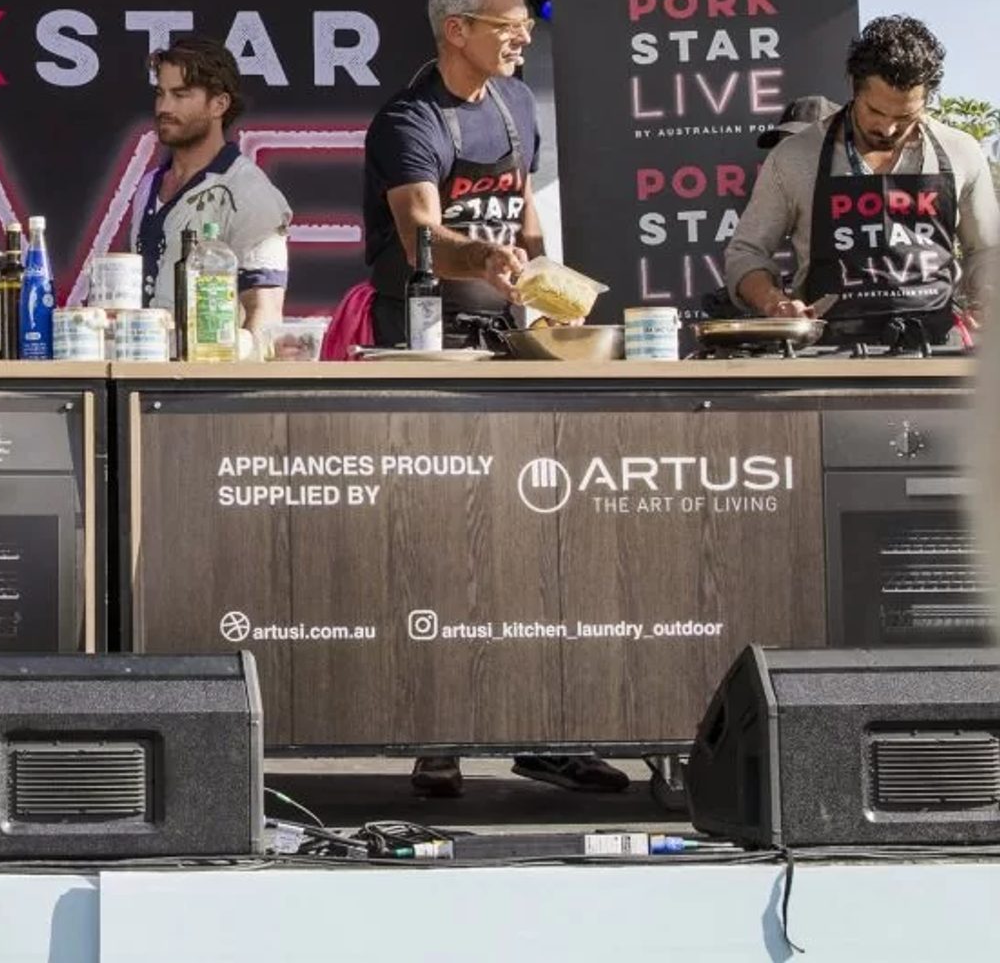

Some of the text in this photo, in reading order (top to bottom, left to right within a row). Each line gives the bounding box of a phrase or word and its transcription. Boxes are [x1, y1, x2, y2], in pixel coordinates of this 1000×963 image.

[631, 27, 780, 65] STAR
[632, 69, 784, 119] LIVE
[635, 124, 776, 139] BY AUSTRALIAN POR
[637, 164, 762, 201] POR
[831, 191, 939, 220] PORK
[639, 208, 740, 247] STA
[834, 222, 936, 252] STAR
[838, 250, 940, 287] LIVE
[217, 454, 494, 477] APPLIANCES PROUDLY
[577, 455, 793, 491] ARTUSI
[218, 485, 381, 506] SUPPLIED BY
[592, 495, 778, 514] THE ART OF LIVING
[252, 623, 376, 640] artusi.com.au
[442, 620, 723, 640] artusi_kitchen_laundry_outdoor
